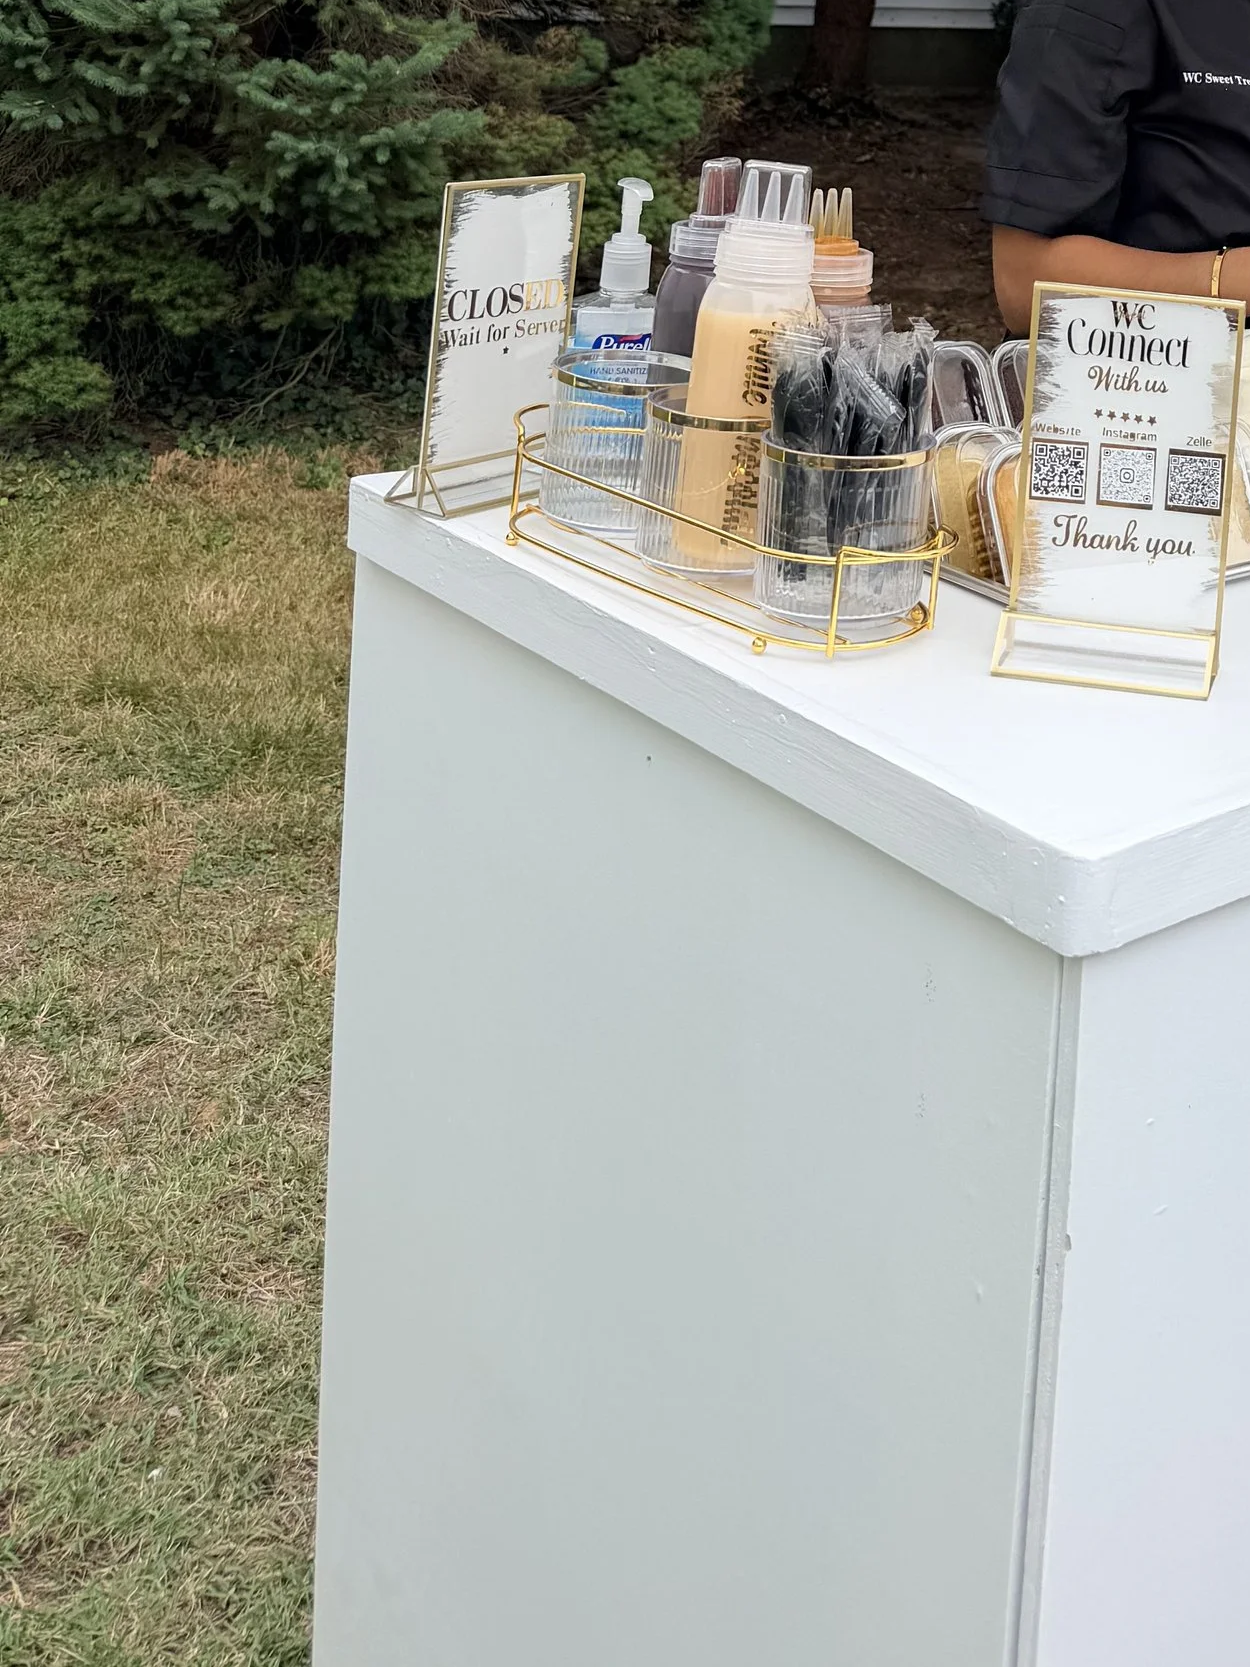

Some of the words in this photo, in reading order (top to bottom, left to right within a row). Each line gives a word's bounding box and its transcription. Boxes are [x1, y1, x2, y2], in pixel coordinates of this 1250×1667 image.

[1182, 72, 1202, 84] WC
[1205, 72, 1234, 84] Sweet
[447, 278, 566, 323] CLOSED
[1110, 300, 1156, 330] WC
[441, 326, 482, 349] Wait
[486, 323, 511, 343] for
[1067, 317, 1192, 368] Connect
[1087, 365, 1142, 393] With
[1145, 379, 1169, 393] us
[1035, 423, 1082, 437] Website
[1102, 427, 1158, 442] Instagram
[1186, 436, 1213, 448] Zelle
[1052, 514, 1140, 552] Thank
